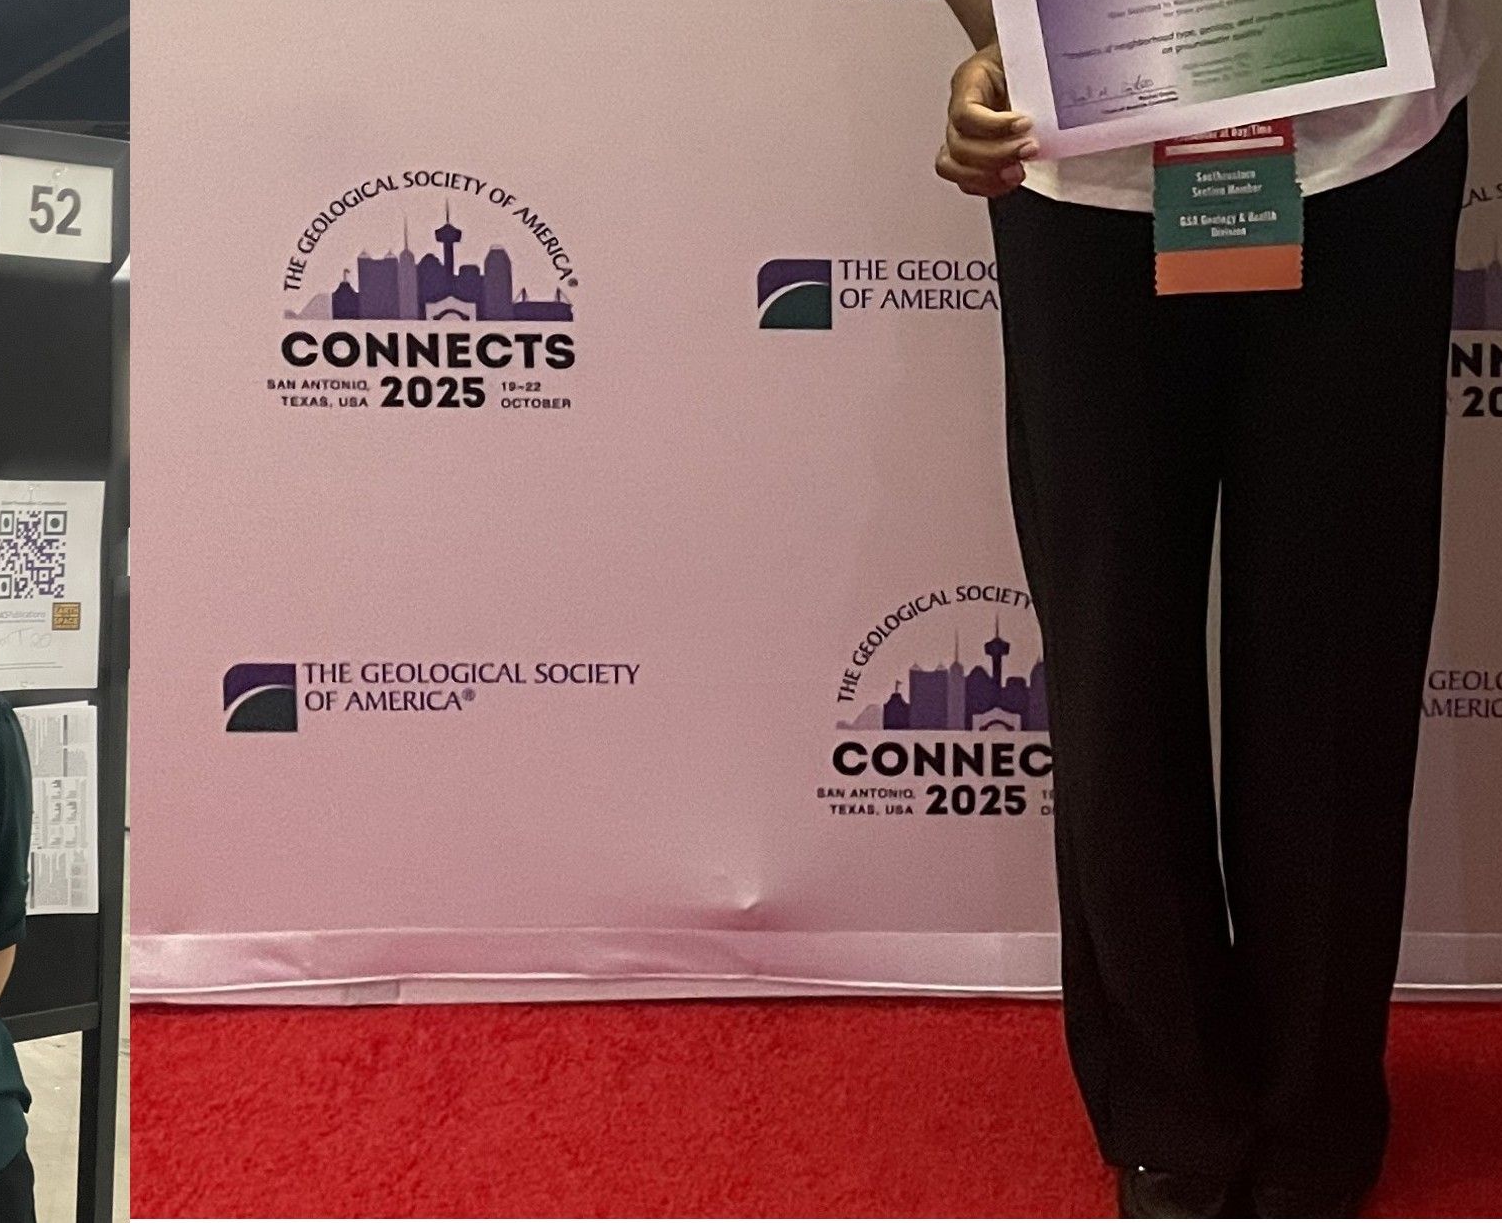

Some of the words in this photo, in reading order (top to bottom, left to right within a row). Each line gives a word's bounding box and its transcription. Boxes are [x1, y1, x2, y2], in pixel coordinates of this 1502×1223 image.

[27, 185, 82, 237] 52
[281, 331, 576, 370] CONNECTS
[381, 376, 486, 409] 2025
[832, 741, 1054, 778] CONNEC
[925, 785, 1027, 816] 2025
